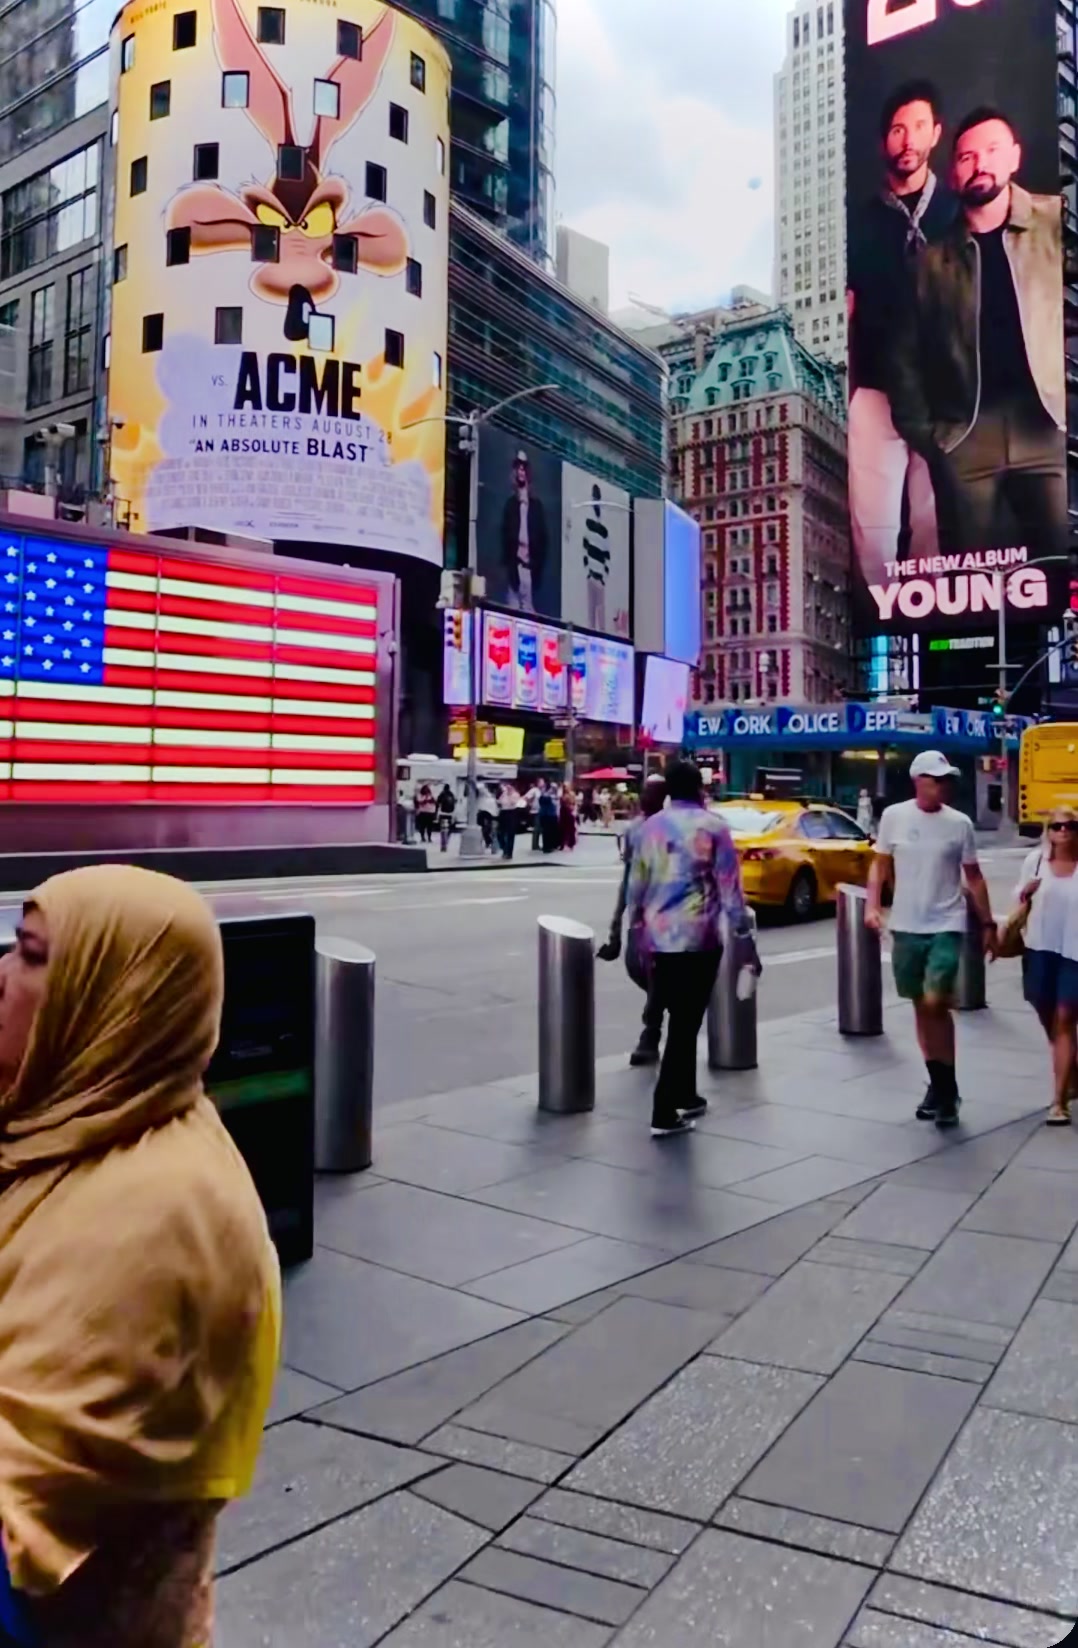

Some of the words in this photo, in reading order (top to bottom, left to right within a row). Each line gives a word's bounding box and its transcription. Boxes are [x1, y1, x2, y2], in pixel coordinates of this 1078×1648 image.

[233, 351, 362, 421] ACME
[192, 414, 208, 428] IN
[218, 413, 302, 430] THEATERS
[312, 418, 371, 440] AUGUST
[220, 439, 300, 454] ABSOLUTE
[884, 558, 917, 577] THE
[919, 553, 961, 574] NEW
[962, 546, 1028, 569] ALBUM
[868, 567, 1049, 620] YOUNG
[776, 706, 839, 735] POLICE
[847, 704, 899, 733] DEPT
